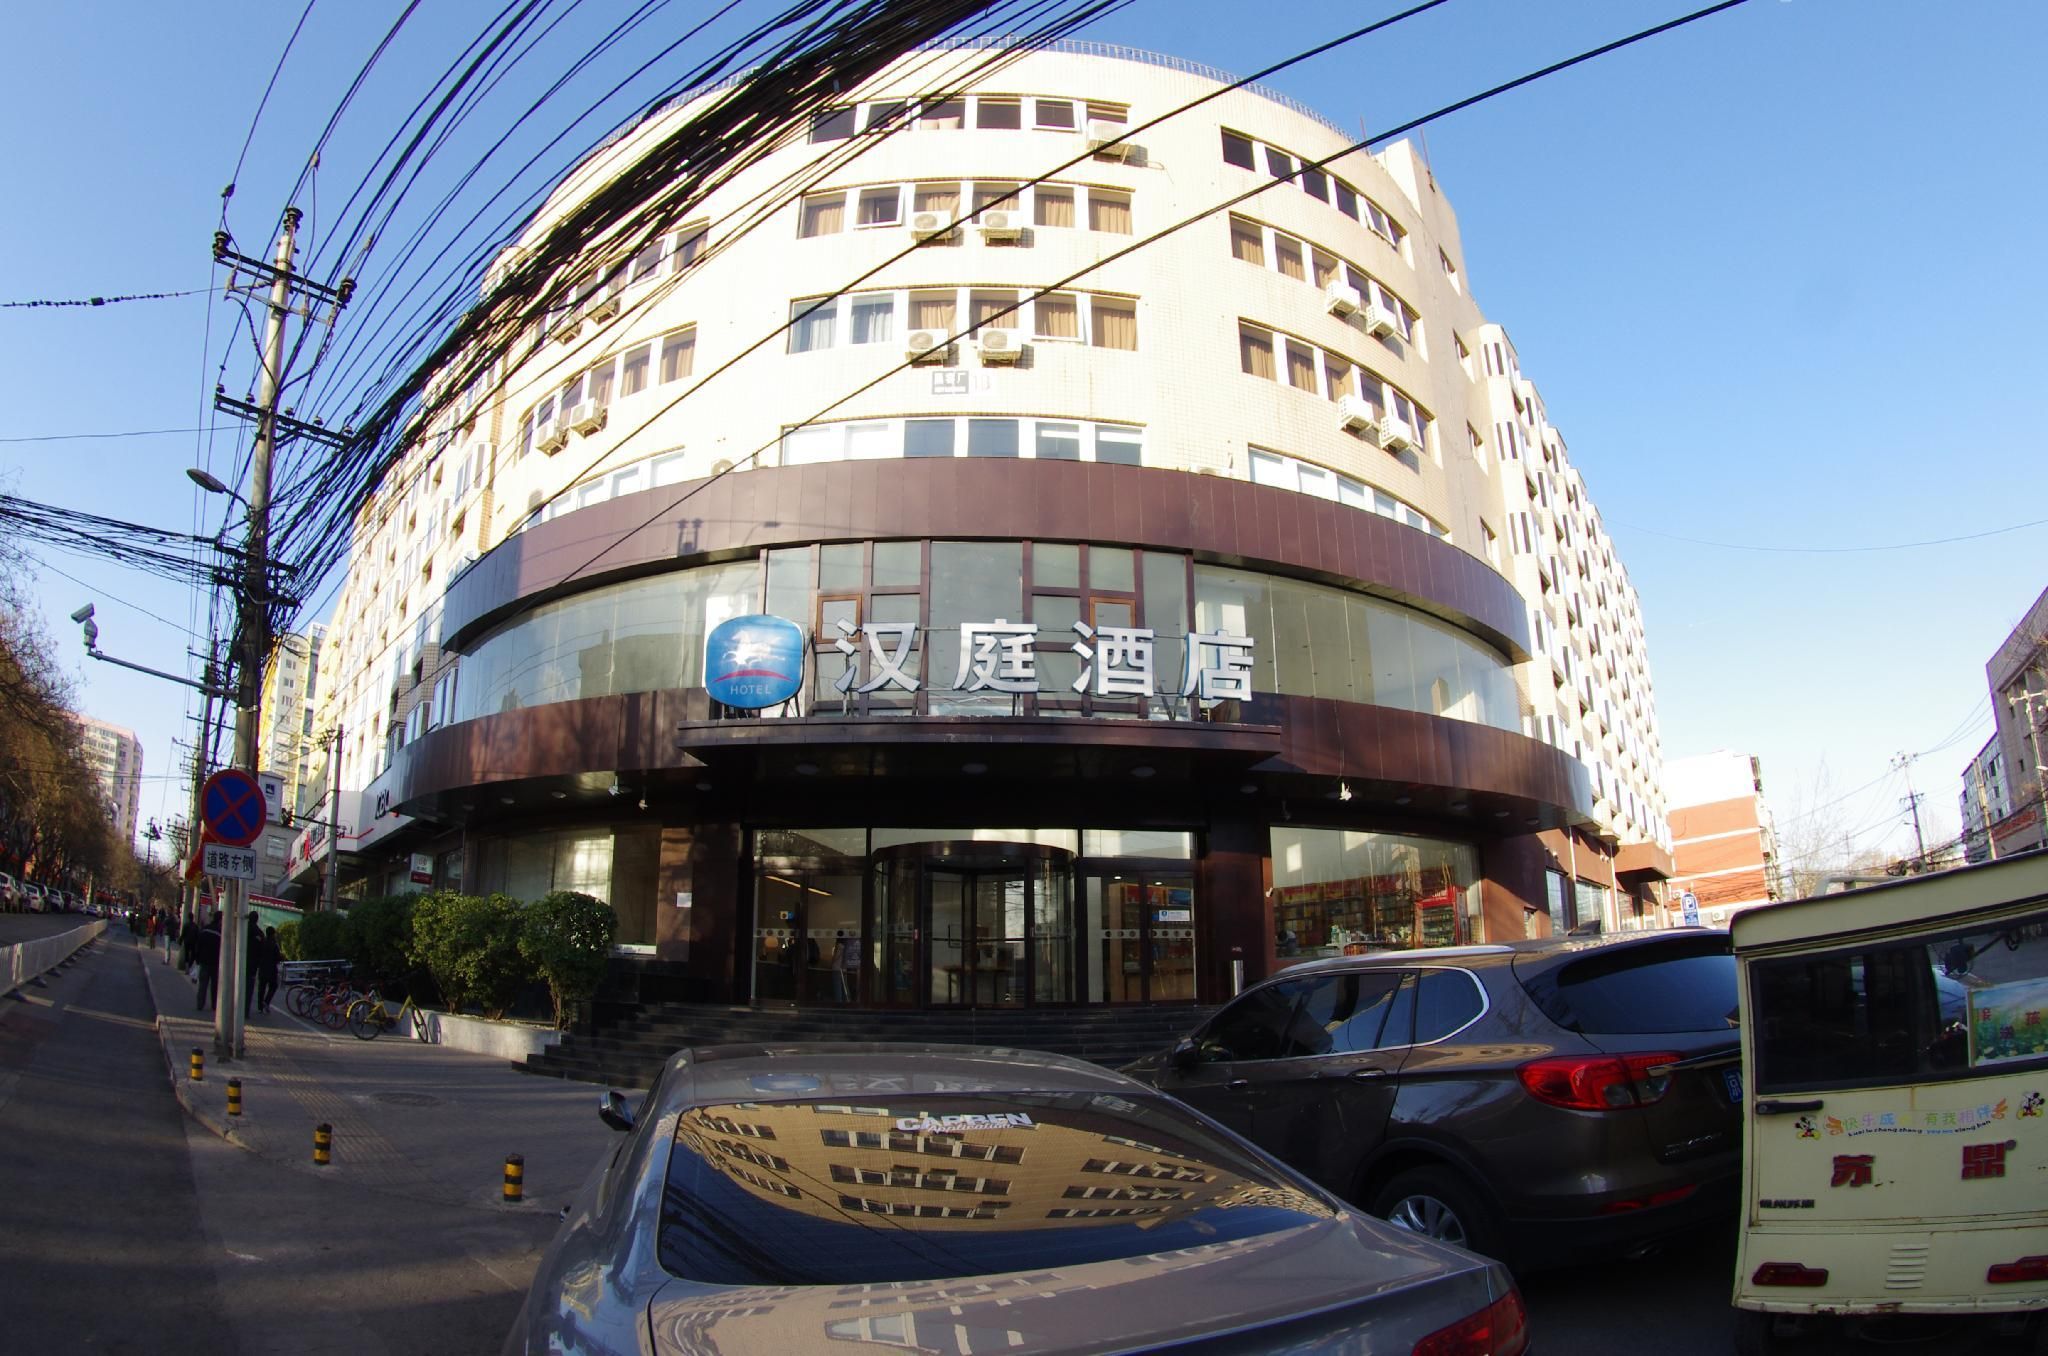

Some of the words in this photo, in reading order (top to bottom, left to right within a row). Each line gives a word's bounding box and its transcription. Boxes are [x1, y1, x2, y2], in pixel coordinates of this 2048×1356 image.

[834, 618, 1254, 702] 汉庭酒店
[730, 684, 772, 696] HOTEL
